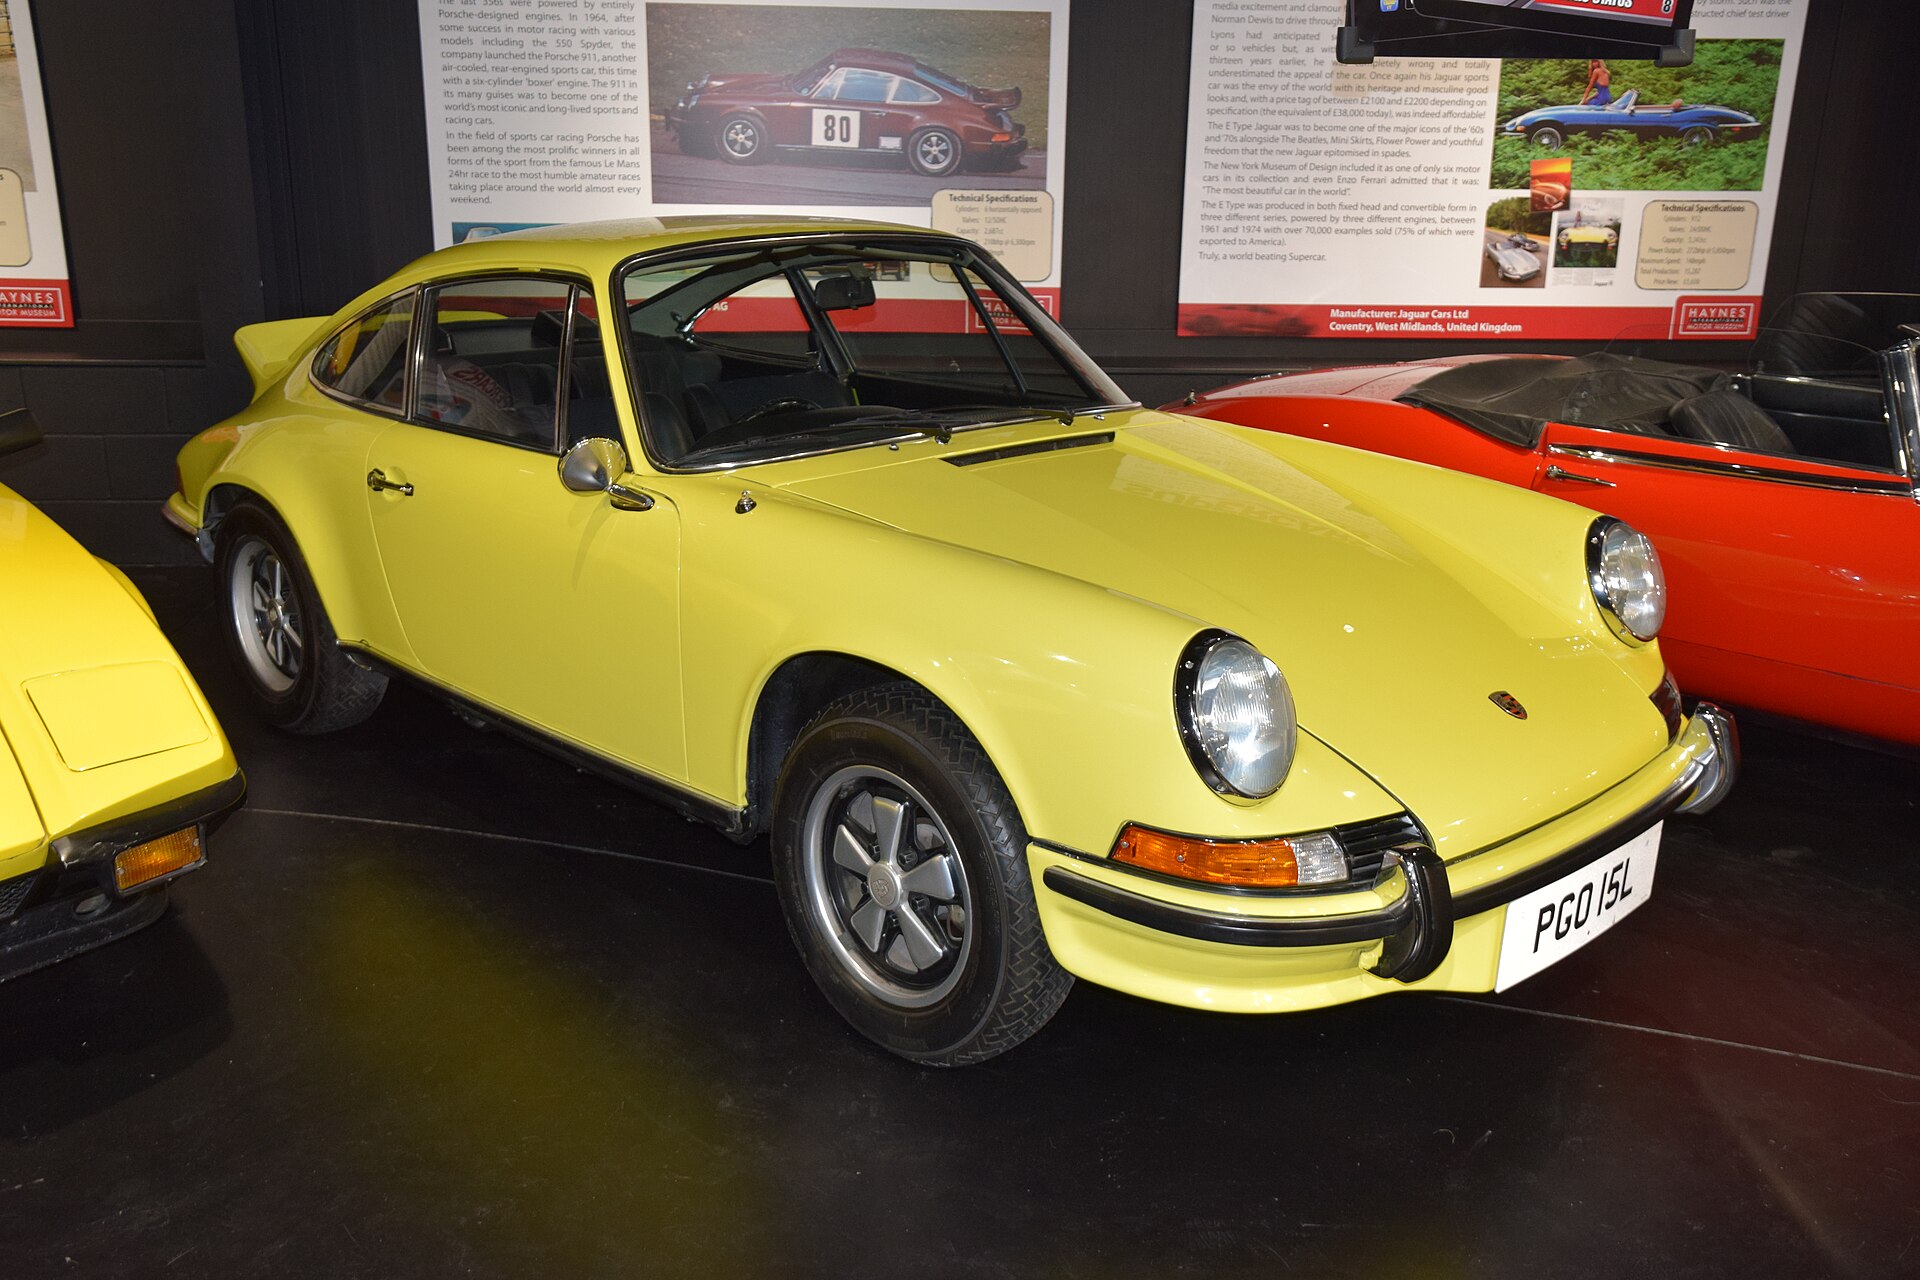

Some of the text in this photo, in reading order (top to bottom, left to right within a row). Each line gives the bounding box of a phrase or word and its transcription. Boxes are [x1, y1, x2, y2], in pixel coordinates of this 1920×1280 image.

[439, 9, 519, 22] Porsche-designed
[568, 12, 578, 21] In
[614, 13, 635, 22] after
[1212, 1, 1790, 18] media excitement and clamour structed chief test driver
[1211, 14, 1342, 27] Norman Dewis to drive through
[468, 25, 502, 33] success
[504, 24, 514, 33] in
[517, 24, 545, 34] motor
[548, 25, 577, 36] racing
[580, 26, 600, 35] with
[603, 26, 636, 36] various
[1211, 30, 1235, 41] Lyons
[1245, 30, 1263, 39] had
[1273, 31, 1320, 42] anticipated
[441, 36, 474, 45] models
[482, 37, 524, 48] including
[532, 38, 547, 47] the
[555, 38, 572, 48] 550
[621, 40, 636, 49] the
[1210, 55, 1243, 65] thirteen
[1250, 58, 1272, 67] years
[1313, 57, 1324, 66] he
[1408, 61, 1435, 70] wrong
[1441, 60, 1458, 68] and
[1464, 60, 1490, 71] totally
[491, 64, 549, 75] rear-engined
[551, 65, 579, 76] sports
[598, 66, 614, 75] this
[616, 66, 637, 75] time
[443, 76, 463, 85] with
[472, 76, 523, 88] six-cylinder
[592, 78, 608, 88] The
[610, 79, 626, 88] 911
[628, 79, 637, 88] in
[477, 102, 499, 112] most
[501, 103, 527, 112] iconic
[528, 104, 546, 113] and
[546, 104, 592, 115] long-lived
[592, 105, 620, 116] sports
[621, 105, 638, 114] and
[824, 114, 850, 143] 80
[1205, 133, 1221, 142] and
[1239, 134, 1279, 145] alongside
[1281, 134, 1296, 143] The
[1330, 135, 1349, 144] Mini
[1375, 136, 1403, 145] Flower
[1404, 136, 1430, 145] Power
[1431, 137, 1448, 146] and
[1449, 137, 1483, 148] youthful
[448, 143, 640, 156] been among the most prolific winners in all
[1223, 173, 1231, 182] in
[1235, 173, 1245, 182] its
[1249, 174, 1289, 183] collection
[1293, 174, 1310, 183] and
[1336, 175, 1357, 184] Enzo
[1360, 175, 1387, 184] Ferrari
[1390, 176, 1428, 185] admitted
[1431, 176, 1448, 185] that
[1452, 176, 1458, 185] it
[450, 182, 641, 195] taking place around the world almost every
[949, 194, 1037, 203] Technical Specifications
[1661, 204, 1745, 213] Technical Specifications
[1201, 212, 1222, 221] three
[1225, 212, 1260, 222] different
[1290, 213, 1327, 224] powered
[1329, 214, 1340, 224] by
[1342, 214, 1364, 223] three
[1366, 214, 1401, 223] different
[1440, 215, 1476, 224] between
[1199, 236, 1237, 247] exported
[1238, 237, 1247, 246] to
[1229, 251, 1254, 260] world
[1254, 252, 1287, 263] beating
[0, 292, 54, 303] AYNES
[712, 301, 729, 311] AG
[1330, 309, 1469, 320] Manufacturer: Jaguar Cars Ltd
[1688, 307, 1746, 318] HAYNES
[1329, 322, 1522, 334] Coventry, West Midlands, United Kingdom
[1533, 857, 1633, 953] PGO 15L
